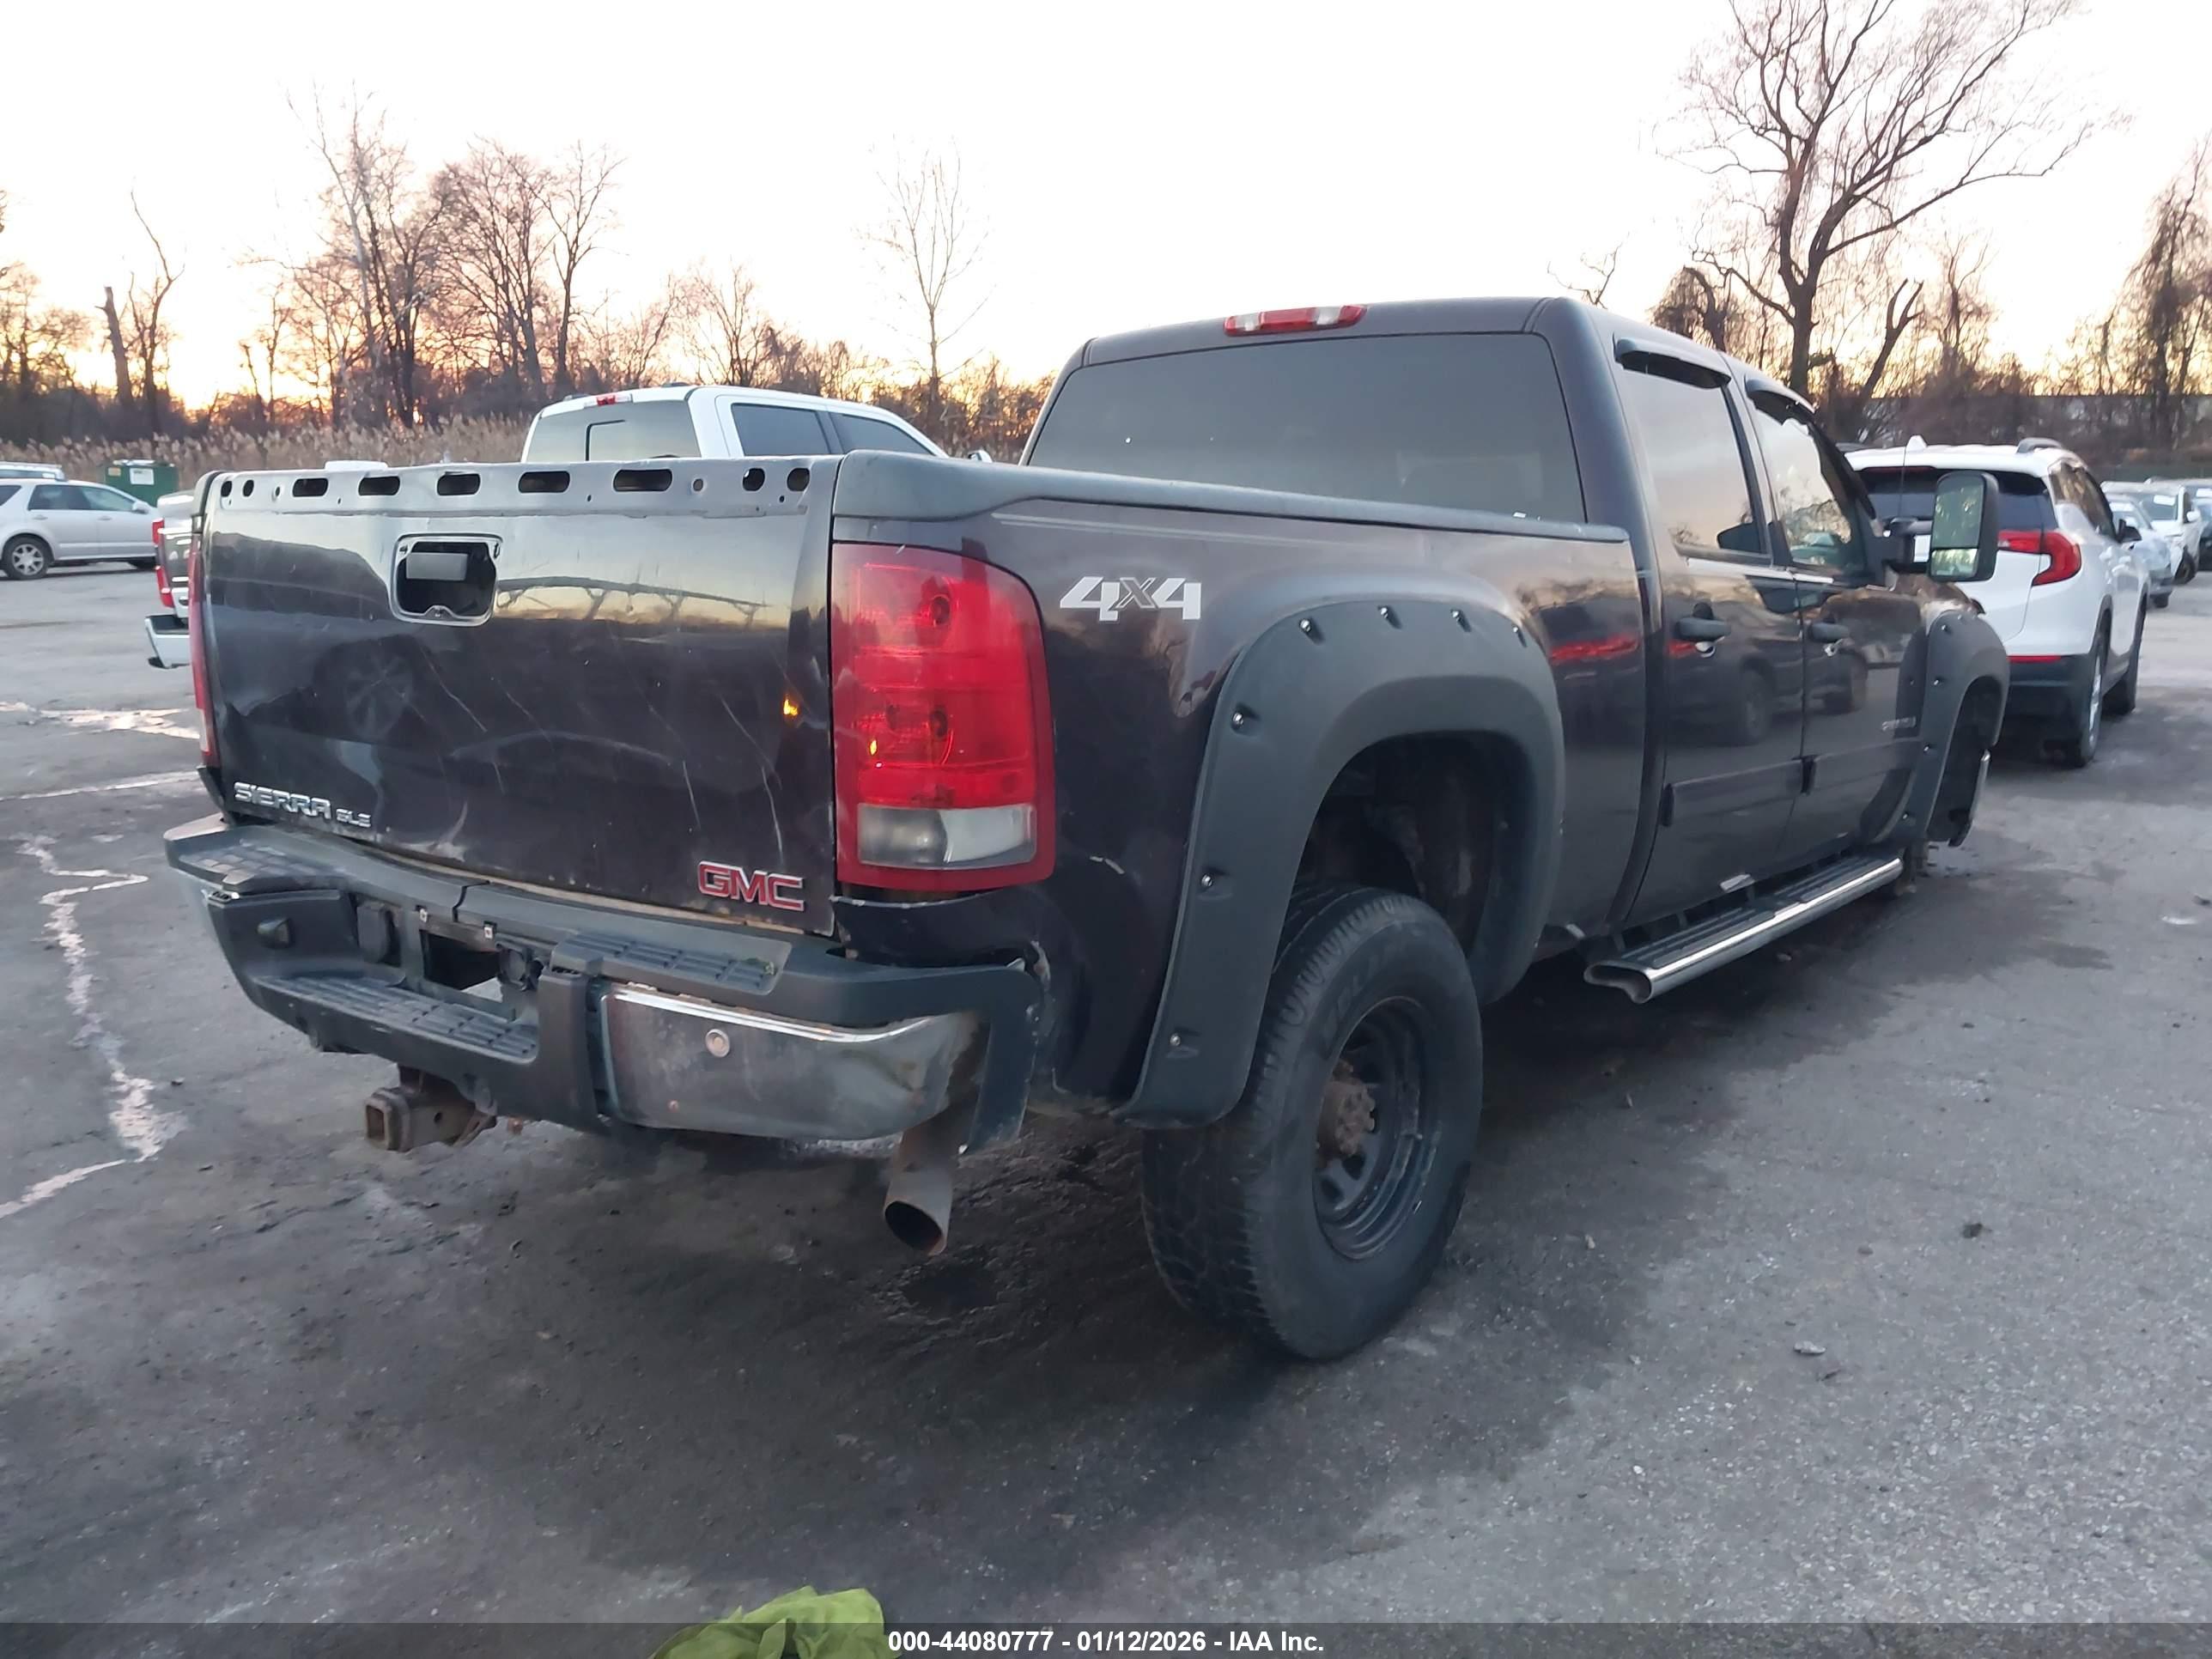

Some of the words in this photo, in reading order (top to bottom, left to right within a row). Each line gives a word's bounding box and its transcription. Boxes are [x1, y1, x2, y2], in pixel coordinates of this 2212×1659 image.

[234, 781, 331, 820] SIERRA
[336, 808, 372, 828] SLE
[698, 860, 805, 911] GMC
